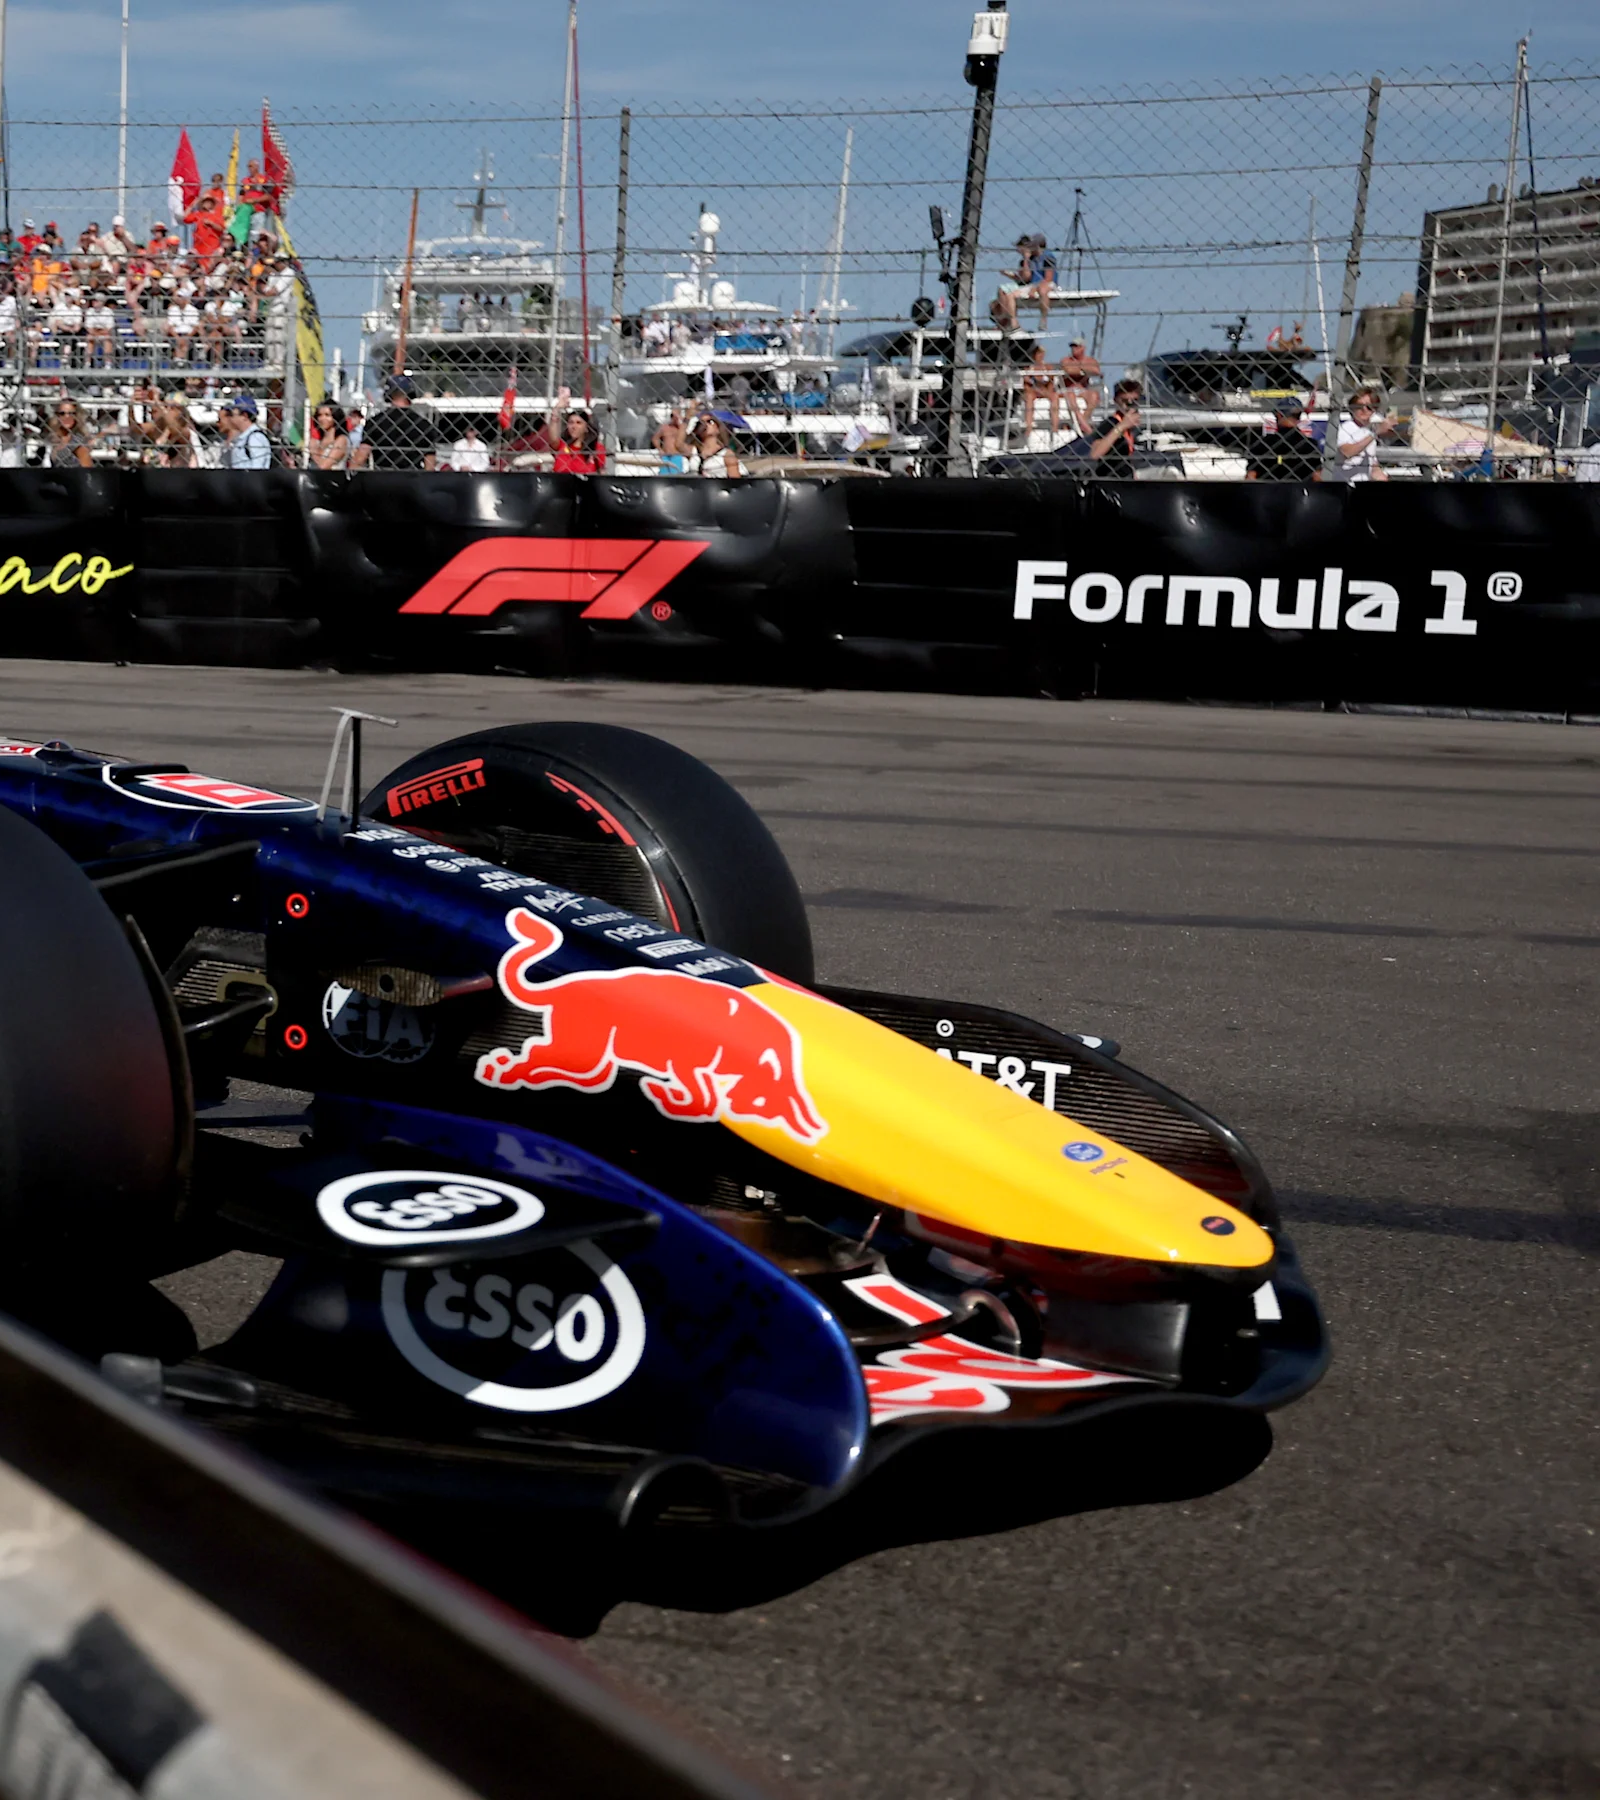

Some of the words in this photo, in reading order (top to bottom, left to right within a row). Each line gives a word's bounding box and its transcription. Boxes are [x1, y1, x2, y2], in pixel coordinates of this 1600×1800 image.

[1014, 560, 1399, 632] Formula
[387, 758, 487, 818] PIRELLI
[636, 939, 707, 960] PIRELLI
[935, 1048, 1072, 1111] T&T
